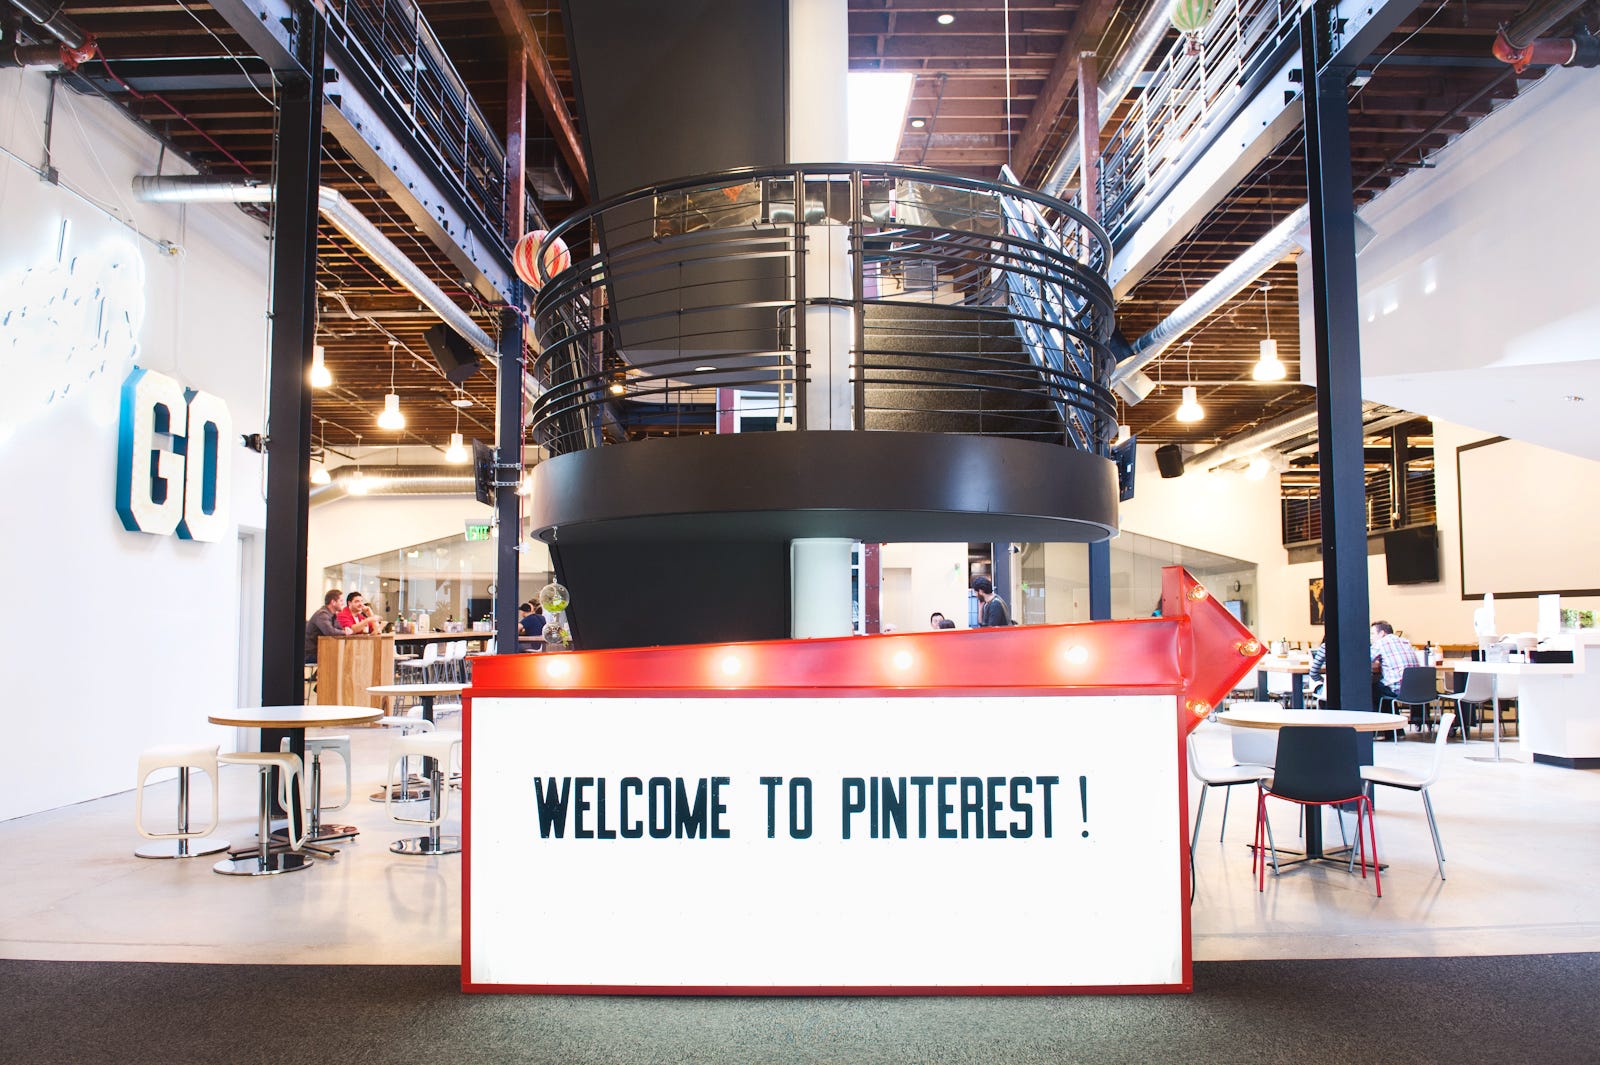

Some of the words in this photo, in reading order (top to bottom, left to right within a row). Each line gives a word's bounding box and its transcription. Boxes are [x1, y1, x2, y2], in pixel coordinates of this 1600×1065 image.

[117, 366, 232, 543] GO
[469, 525, 490, 541] EXIT
[533, 776, 731, 839] WELCOME
[759, 776, 813, 839] TO
